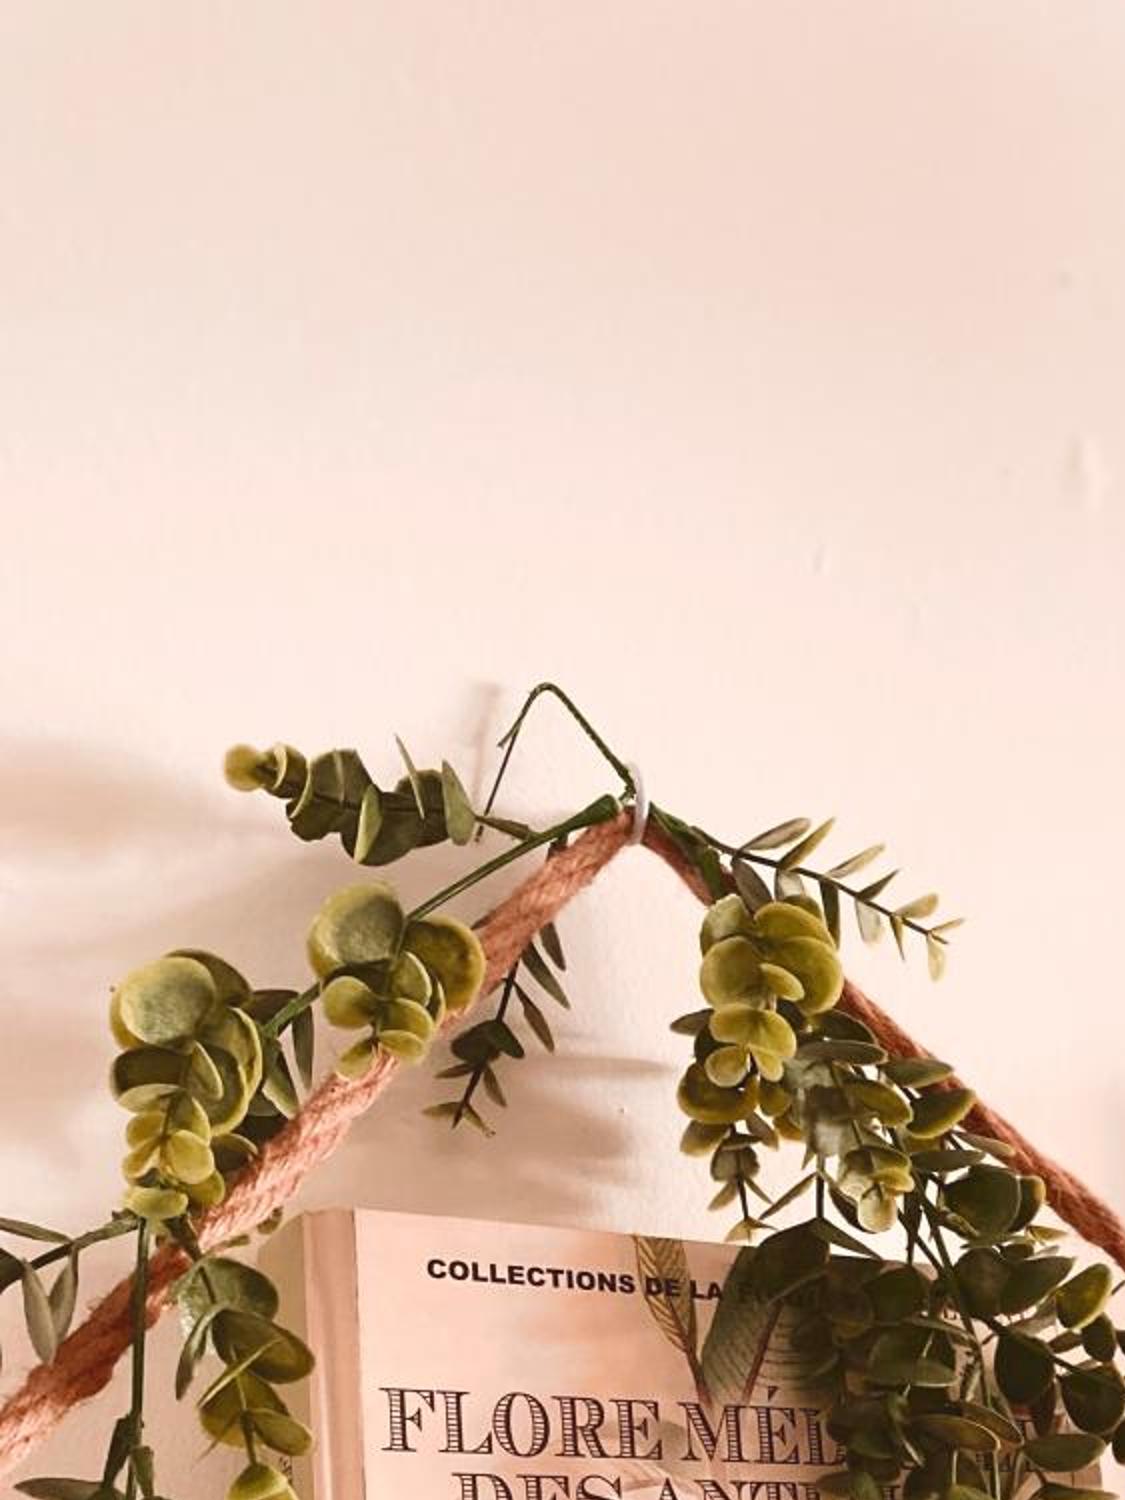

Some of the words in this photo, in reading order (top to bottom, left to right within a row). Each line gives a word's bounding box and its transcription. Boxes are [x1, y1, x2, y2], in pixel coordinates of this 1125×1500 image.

[426, 1258, 636, 1294] COLLECTIONS
[644, 1276, 682, 1297] DE
[689, 1279, 722, 1300] LA
[379, 1387, 663, 1461] FLORE
